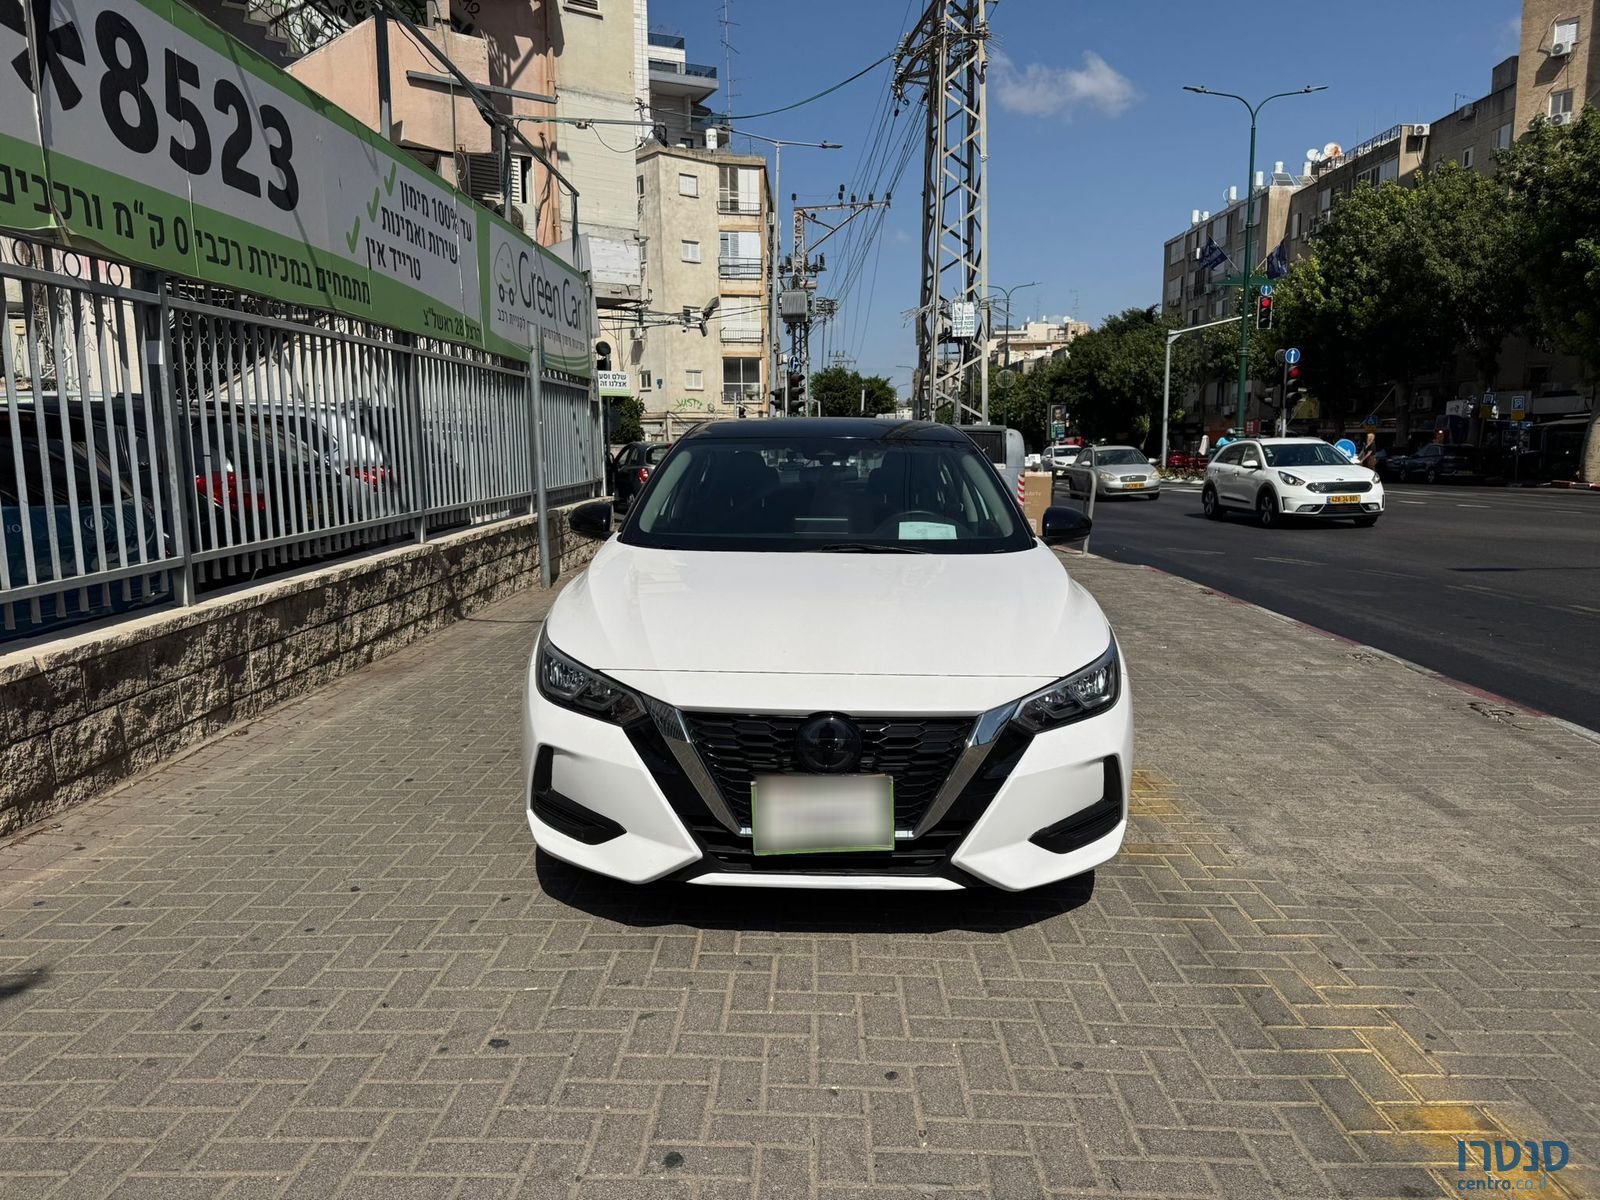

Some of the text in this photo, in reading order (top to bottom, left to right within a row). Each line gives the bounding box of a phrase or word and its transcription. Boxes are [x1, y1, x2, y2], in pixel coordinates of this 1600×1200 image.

[400, 180, 472, 242] עד 100% מימון
[195, 230, 243, 271] רכבי
[381, 206, 458, 264] שירות ואמינות
[247, 245, 313, 289] במכירת
[366, 236, 421, 280] טרייד אין
[315, 266, 371, 305] מתמחים
[519, 251, 581, 331] Green Car
[454, 317, 464, 337] 28
